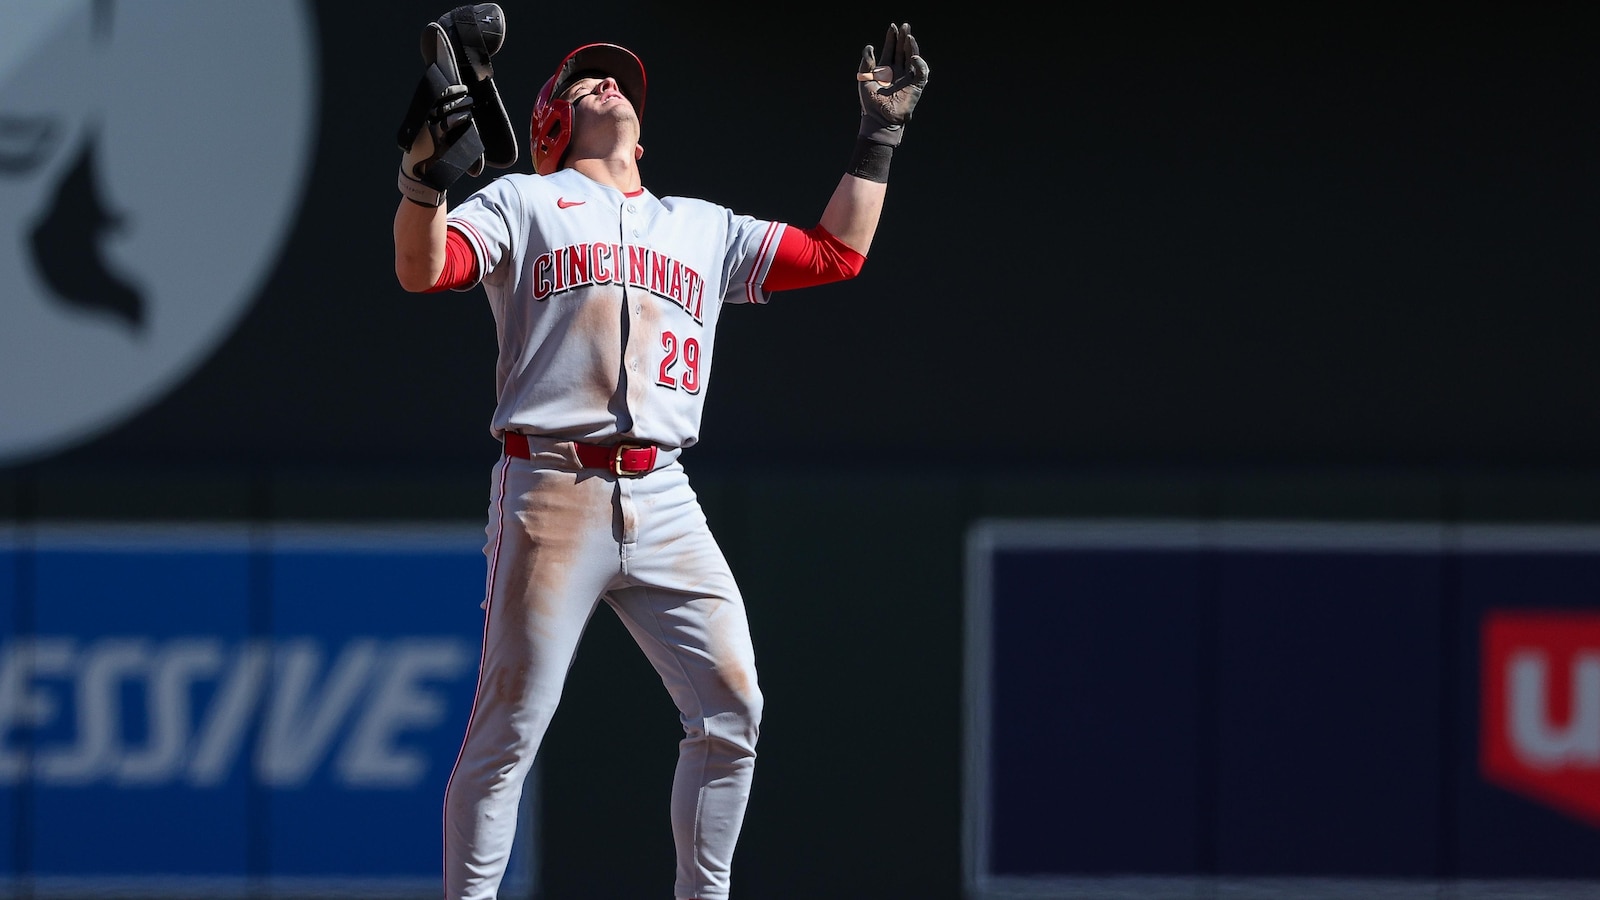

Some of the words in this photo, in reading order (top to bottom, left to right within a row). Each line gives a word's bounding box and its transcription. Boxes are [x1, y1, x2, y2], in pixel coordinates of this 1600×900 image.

[532, 241, 705, 327] CINCINNATI
[655, 329, 701, 394] 29
[0, 637, 470, 786] ESSIVE
